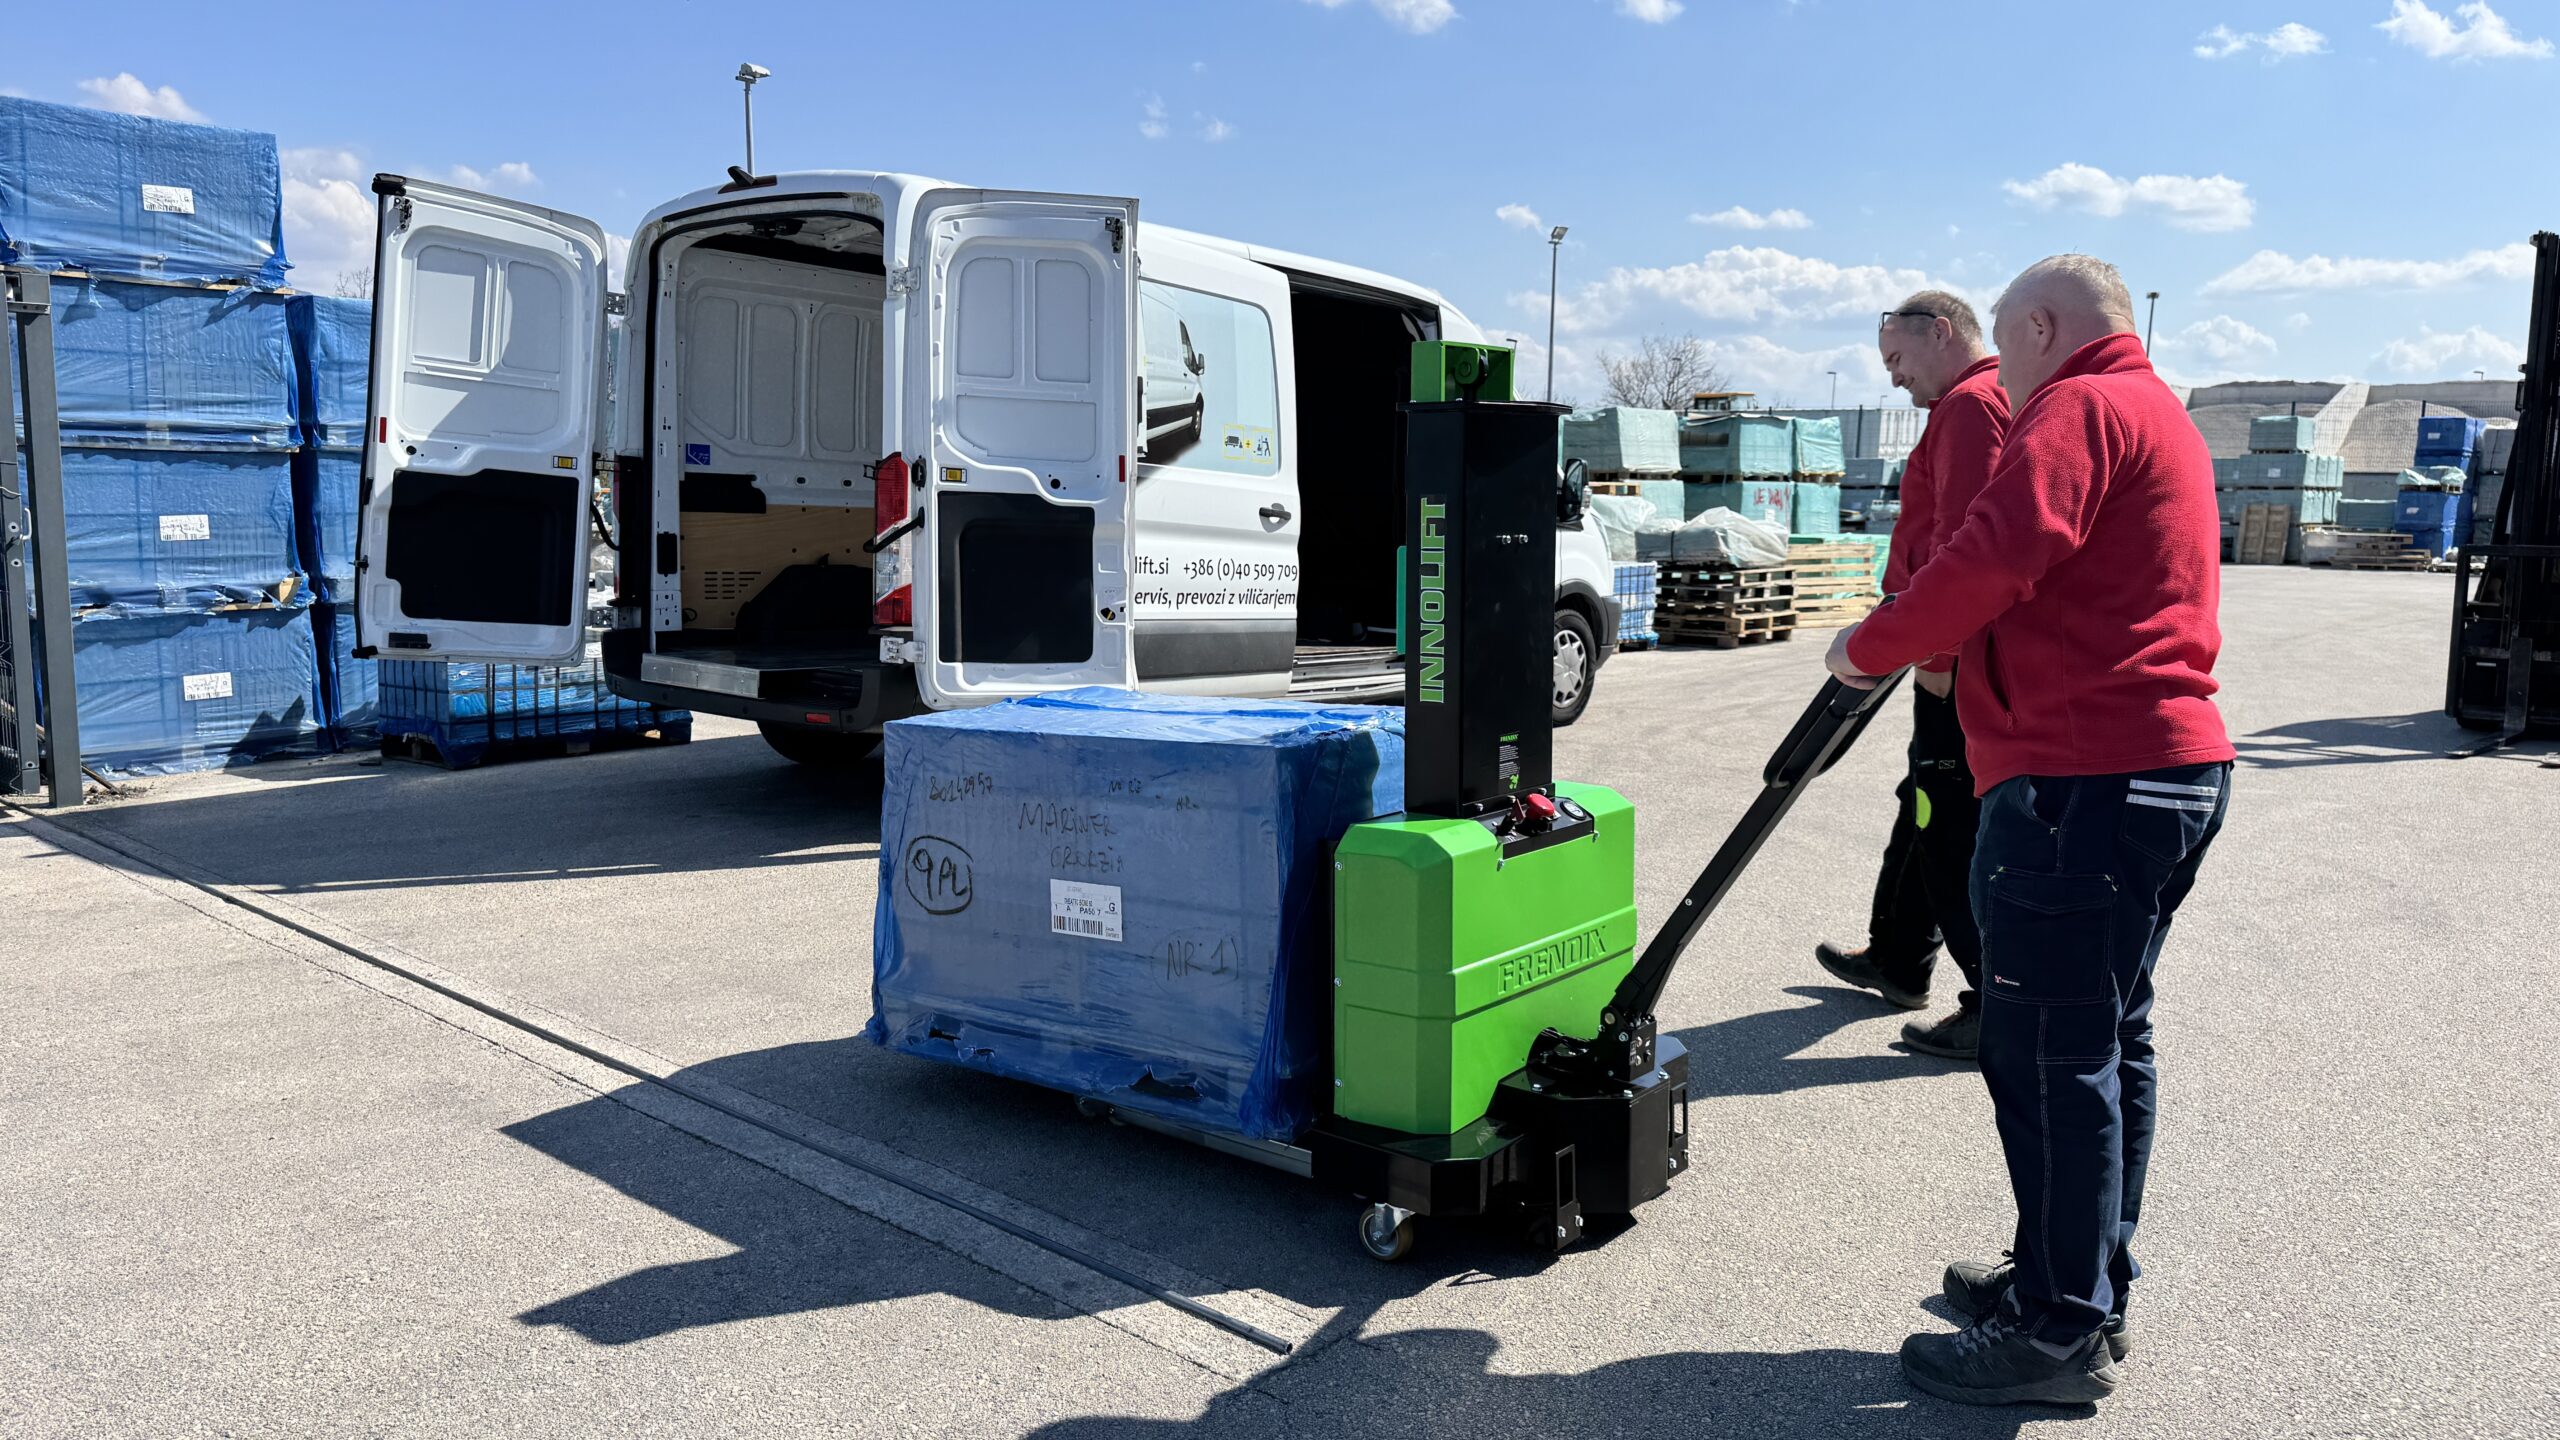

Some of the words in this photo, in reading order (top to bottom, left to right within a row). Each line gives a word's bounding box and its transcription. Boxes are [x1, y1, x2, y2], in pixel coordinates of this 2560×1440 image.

[1134, 556, 1169, 575] lift.si
[1183, 559, 1214, 580] +386
[1217, 558, 1251, 581] (0)40
[1254, 563, 1275, 581] 509
[1277, 564, 1298, 582] 709
[1134, 587, 1172, 609] ervis,
[1176, 588, 1227, 610] prevozi
[1228, 593, 1235, 605] z
[1238, 588, 1296, 609] viličarjem
[1419, 497, 1446, 704] INNOLIFT
[1108, 902, 1116, 912] G
[1498, 925, 1606, 995] FRENDIX
